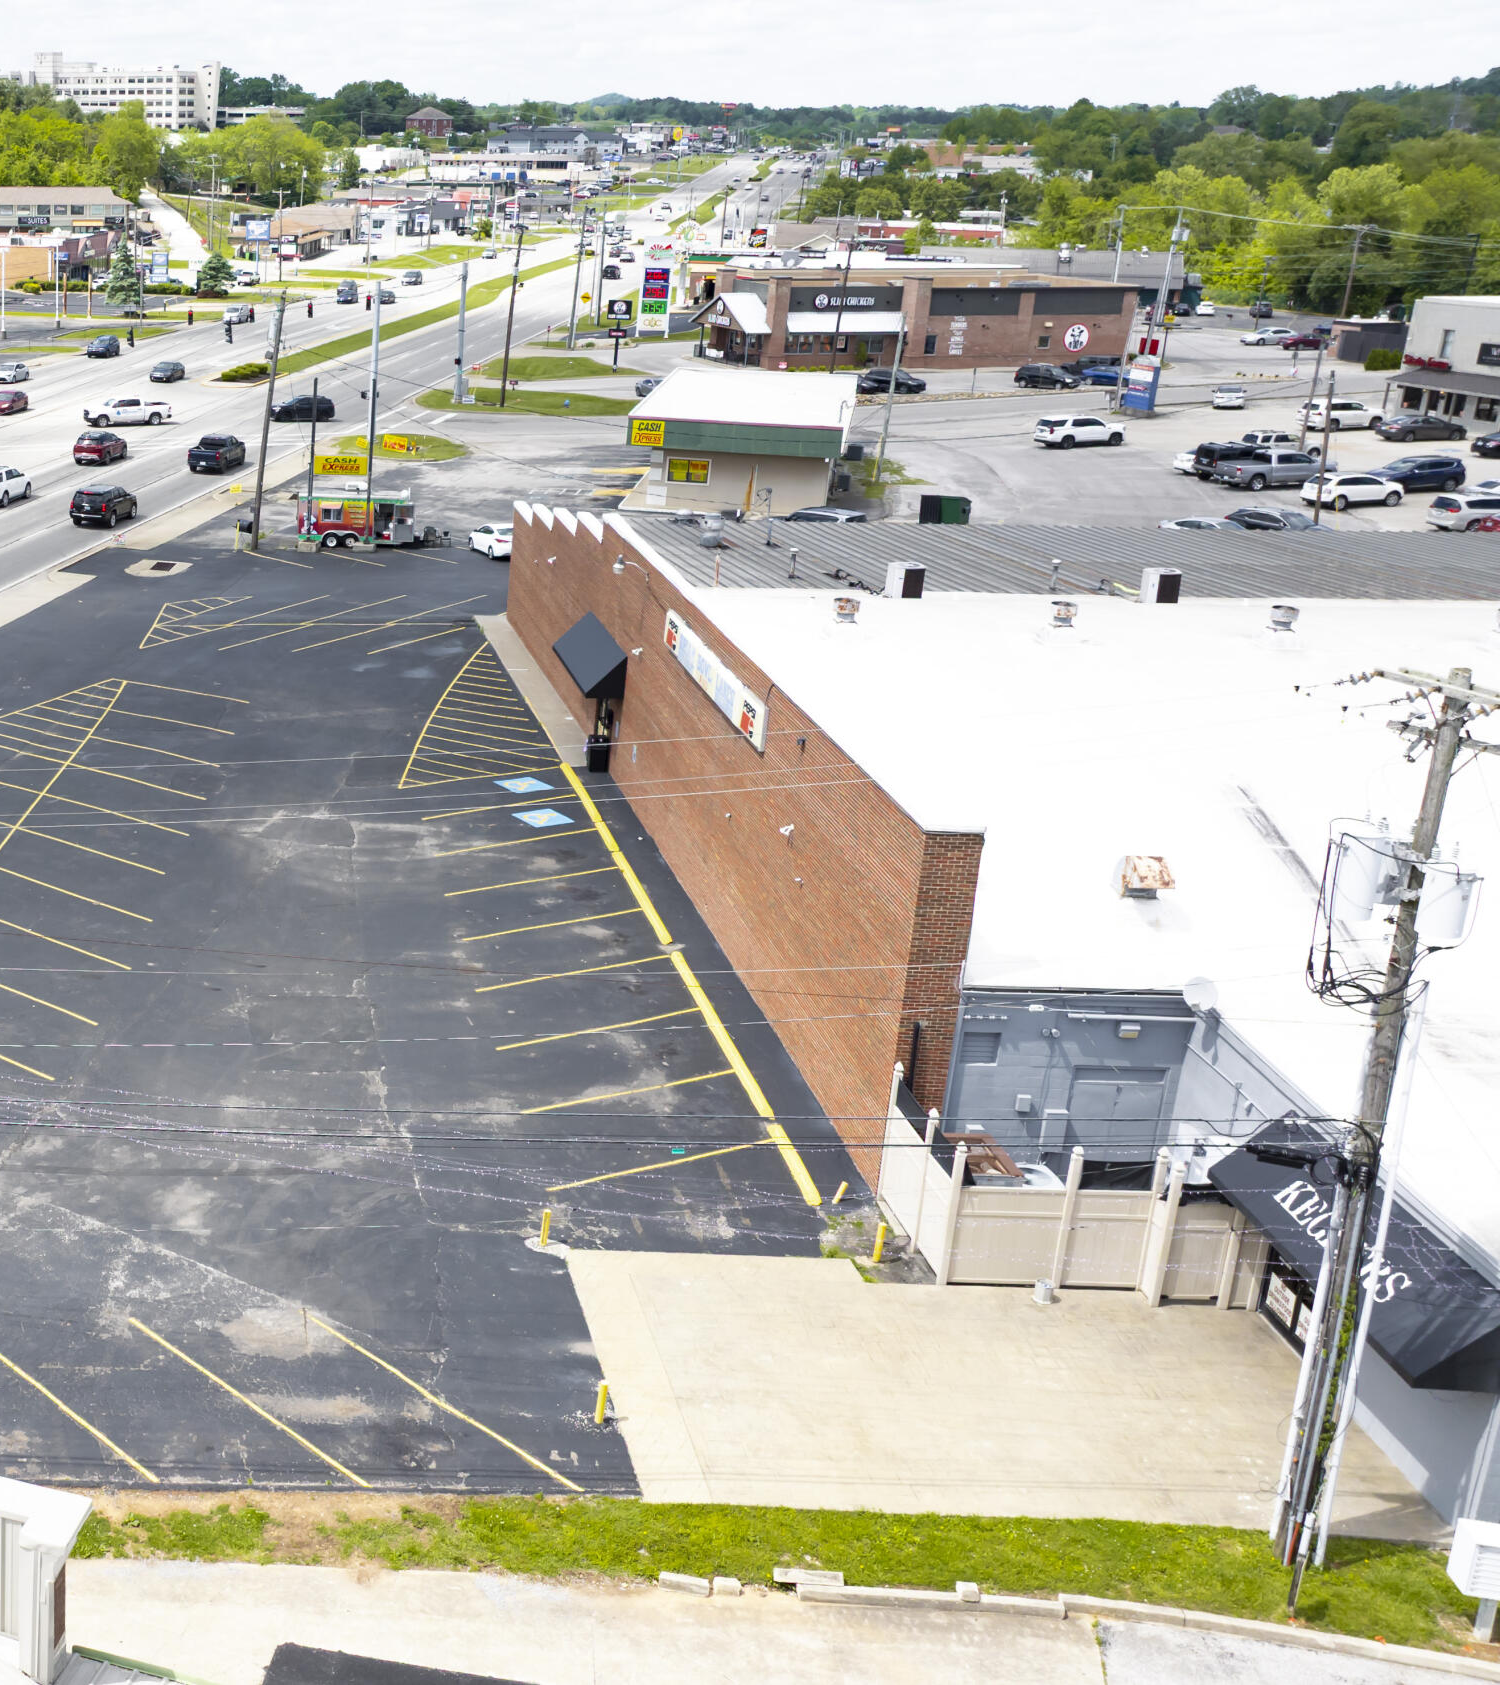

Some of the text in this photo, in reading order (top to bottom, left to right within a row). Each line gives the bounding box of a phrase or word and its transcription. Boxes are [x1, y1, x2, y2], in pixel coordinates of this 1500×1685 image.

[637, 422, 662, 432] CASH
[633, 433, 662, 444] EXPRESS
[322, 463, 360, 471] EXPRESS
[1272, 1180, 1412, 1302] KEGRS
